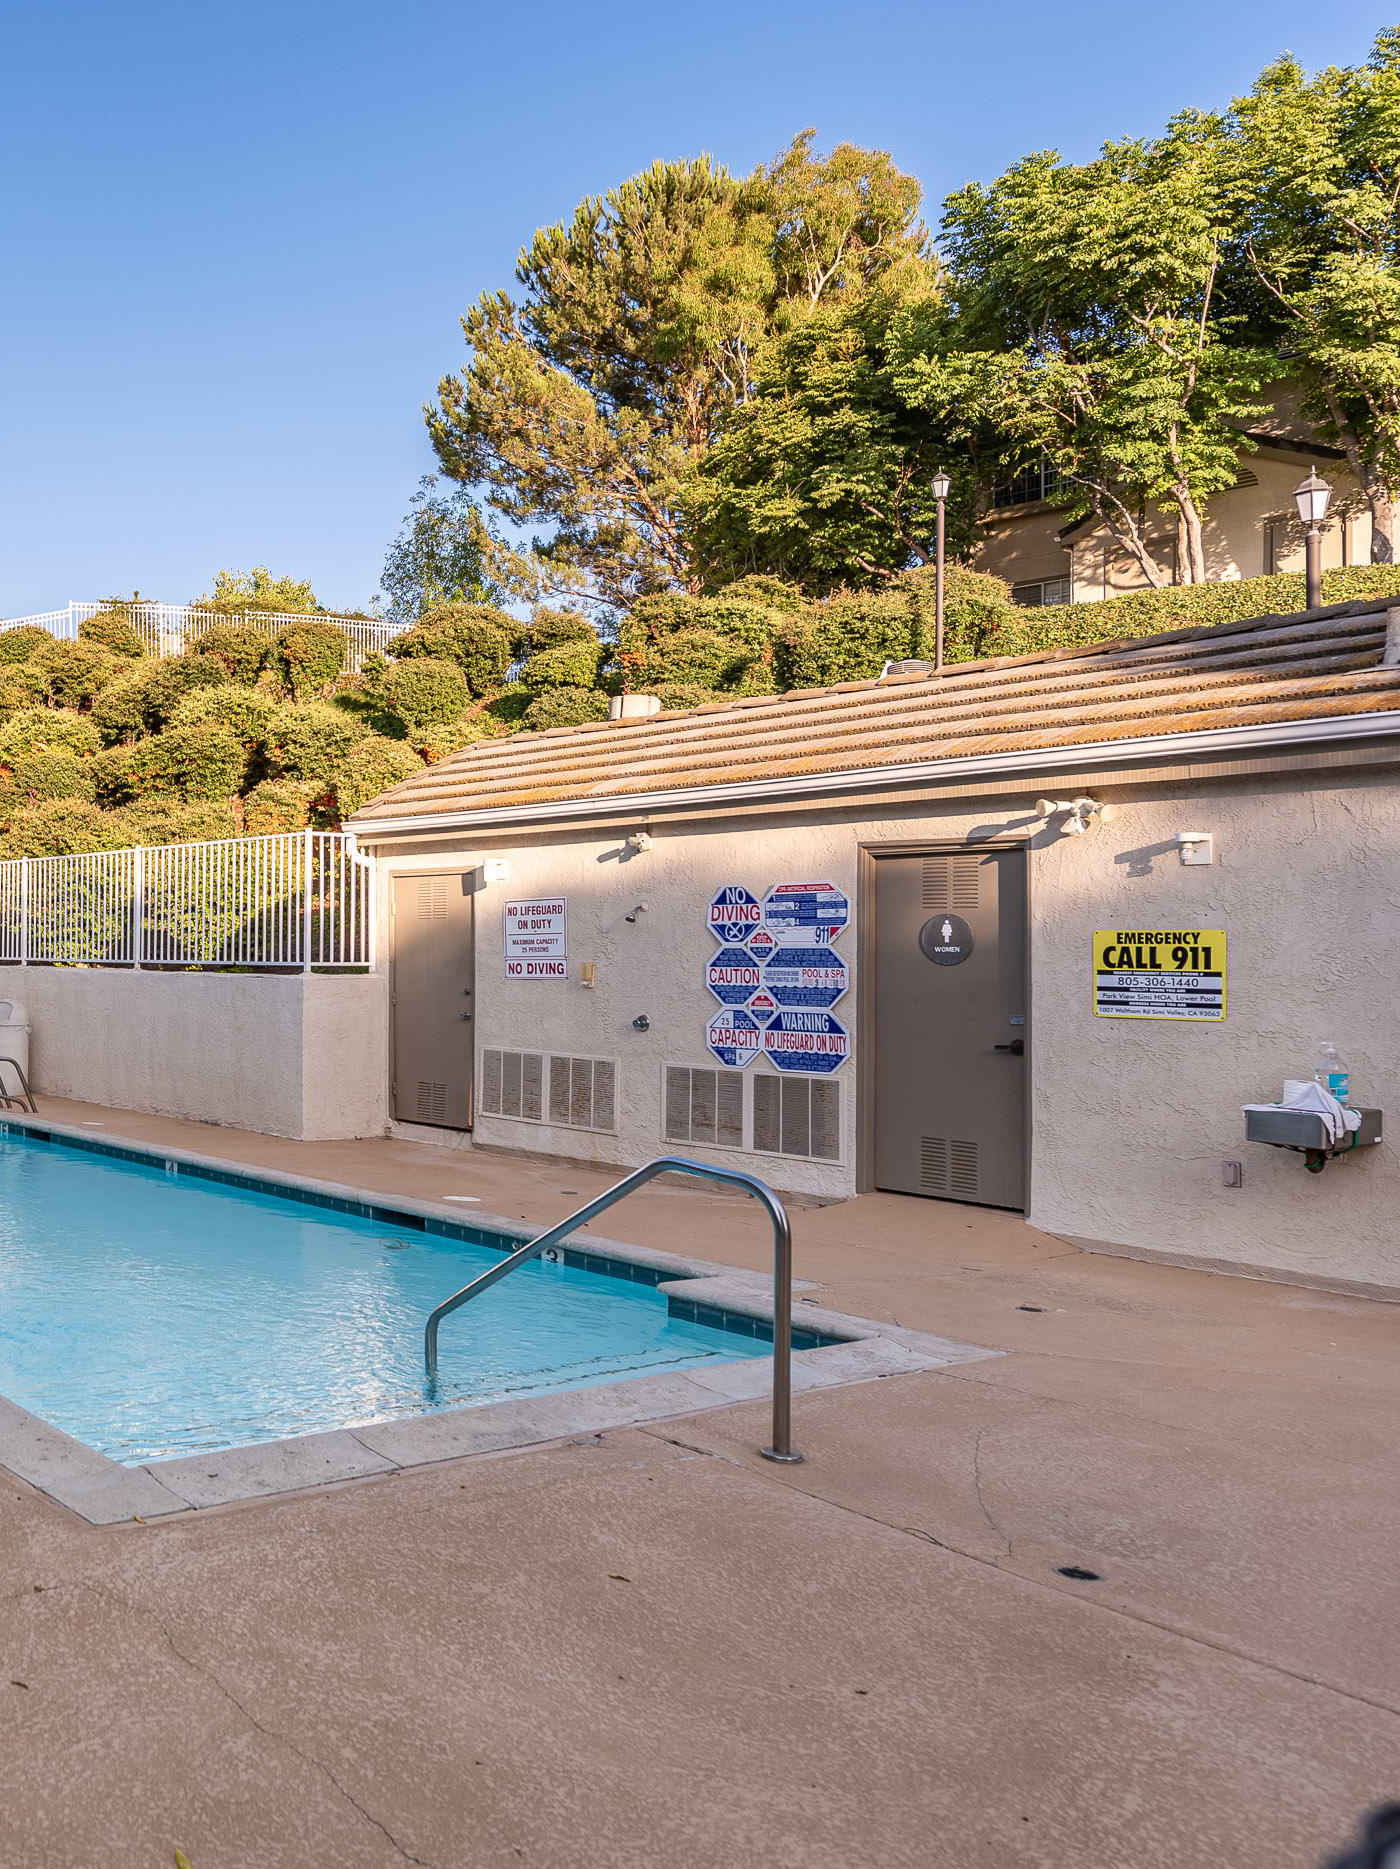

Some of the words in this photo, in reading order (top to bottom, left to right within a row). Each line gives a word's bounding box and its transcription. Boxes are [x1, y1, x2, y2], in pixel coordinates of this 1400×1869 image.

[726, 887, 746, 904] NO
[508, 906, 518, 916] NO
[520, 905, 562, 916] LIFEGUARD
[711, 905, 760, 921] DIVING
[518, 920, 528, 929] ON
[531, 919, 552, 929] DUTY
[815, 926, 829, 943] 911
[1117, 932, 1200, 944] EMERGENCY
[1103, 946, 1162, 969] CALL
[1172, 946, 1212, 970] 911
[508, 963, 523, 974] NO
[527, 963, 565, 974] DIVING
[710, 968, 760, 984] CAUTION
[802, 969, 822, 978] POOL
[824, 969, 829, 978] &
[831, 970, 845, 978] SPA
[1118, 977, 1199, 987] 805-306-1440
[781, 1013, 829, 1032] WARNING
[710, 1029, 760, 1047] CAPACITY
[765, 1032, 774, 1048] NO
[777, 1033, 814, 1050] LIFEGUARD
[816, 1035, 826, 1051] ON
[829, 1036, 846, 1052] DUTY
